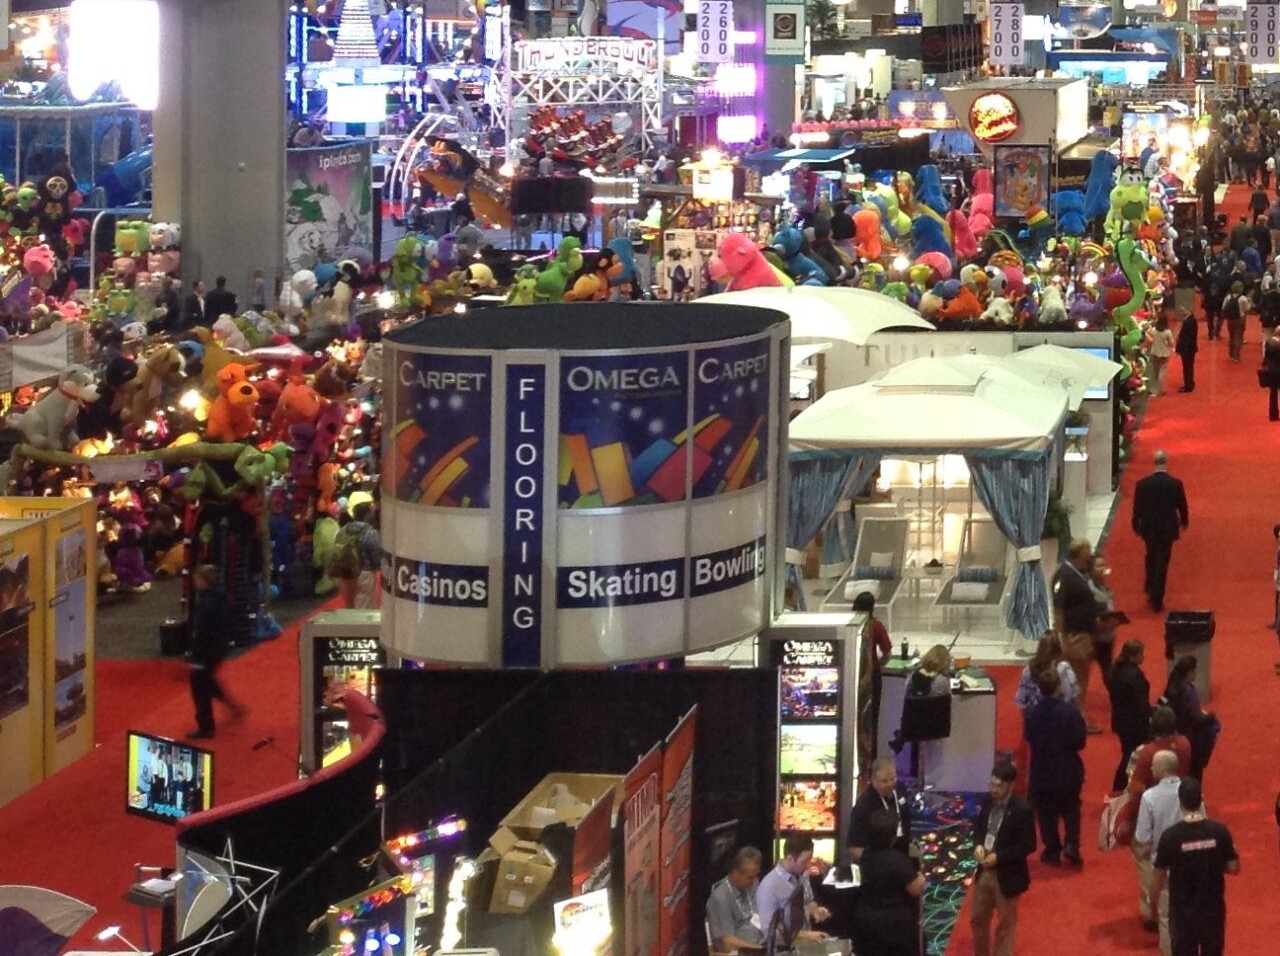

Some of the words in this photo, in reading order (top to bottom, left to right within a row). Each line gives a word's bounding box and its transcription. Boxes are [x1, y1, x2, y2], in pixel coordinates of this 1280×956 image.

[400, 359, 486, 393] CARPET
[567, 366, 681, 392] OMEGA
[698, 353, 768, 384] CARPET
[513, 378, 537, 629] FLOORING
[397, 565, 488, 601] Casinos
[567, 567, 677, 599] Skating
[695, 546, 765, 586] Bowling
